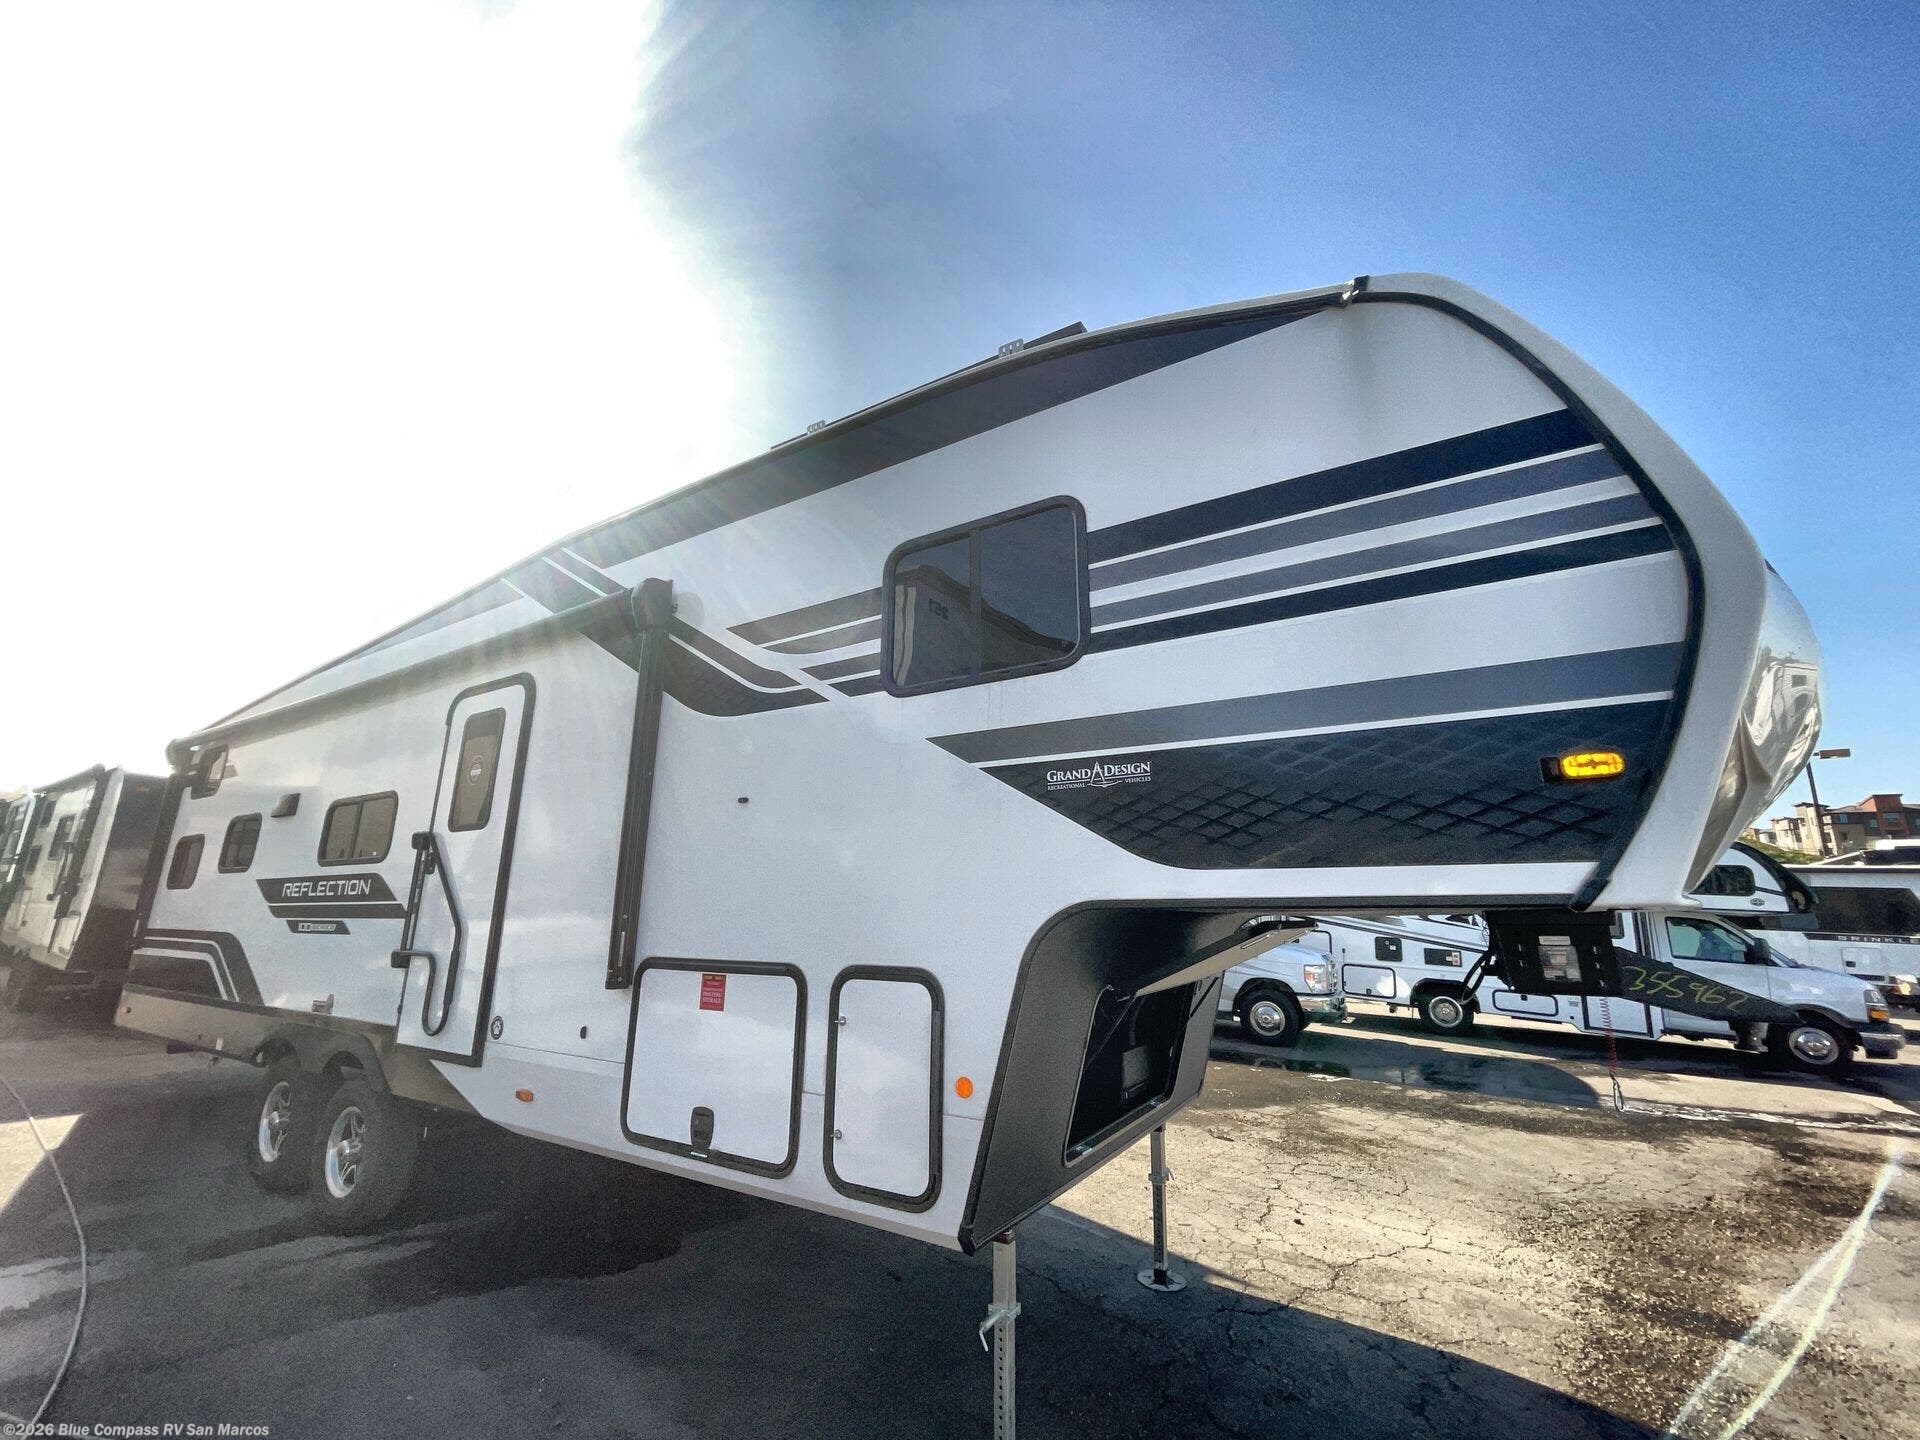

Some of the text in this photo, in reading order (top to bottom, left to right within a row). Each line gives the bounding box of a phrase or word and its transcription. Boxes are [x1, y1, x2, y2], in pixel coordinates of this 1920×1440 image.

[1046, 762, 1151, 782] GRAND DESIGN
[1047, 782, 1086, 791] RECREATIONAL
[282, 879, 371, 897] REFLECTION
